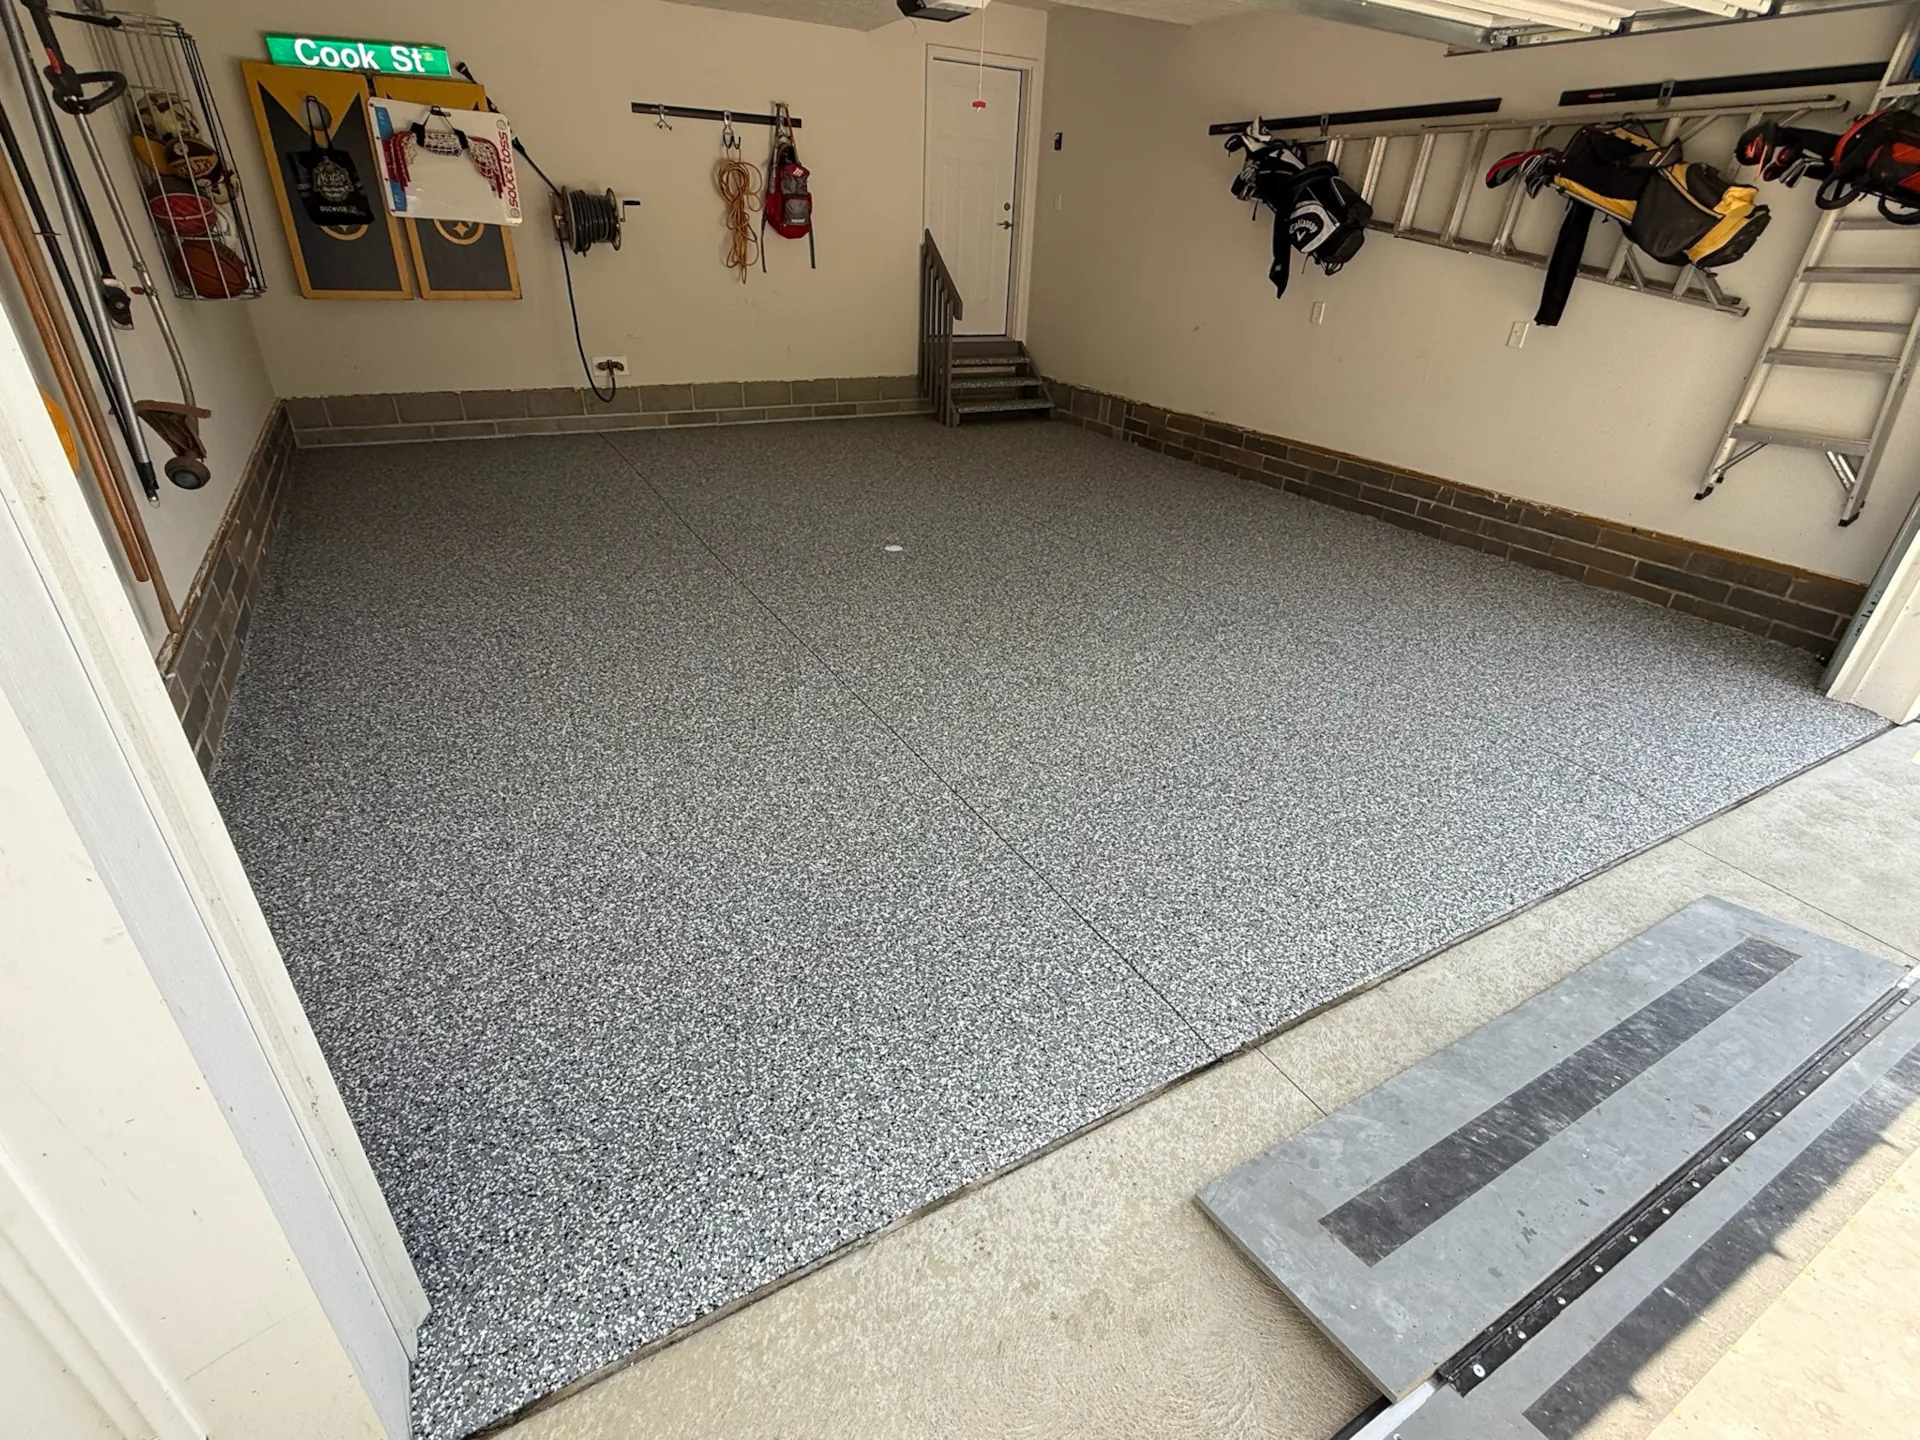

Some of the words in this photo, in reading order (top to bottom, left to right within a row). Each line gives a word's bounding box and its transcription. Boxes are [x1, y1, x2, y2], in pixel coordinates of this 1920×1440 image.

[294, 38, 381, 70] Cook
[390, 45, 426, 73] St
[498, 131, 512, 164] toss
